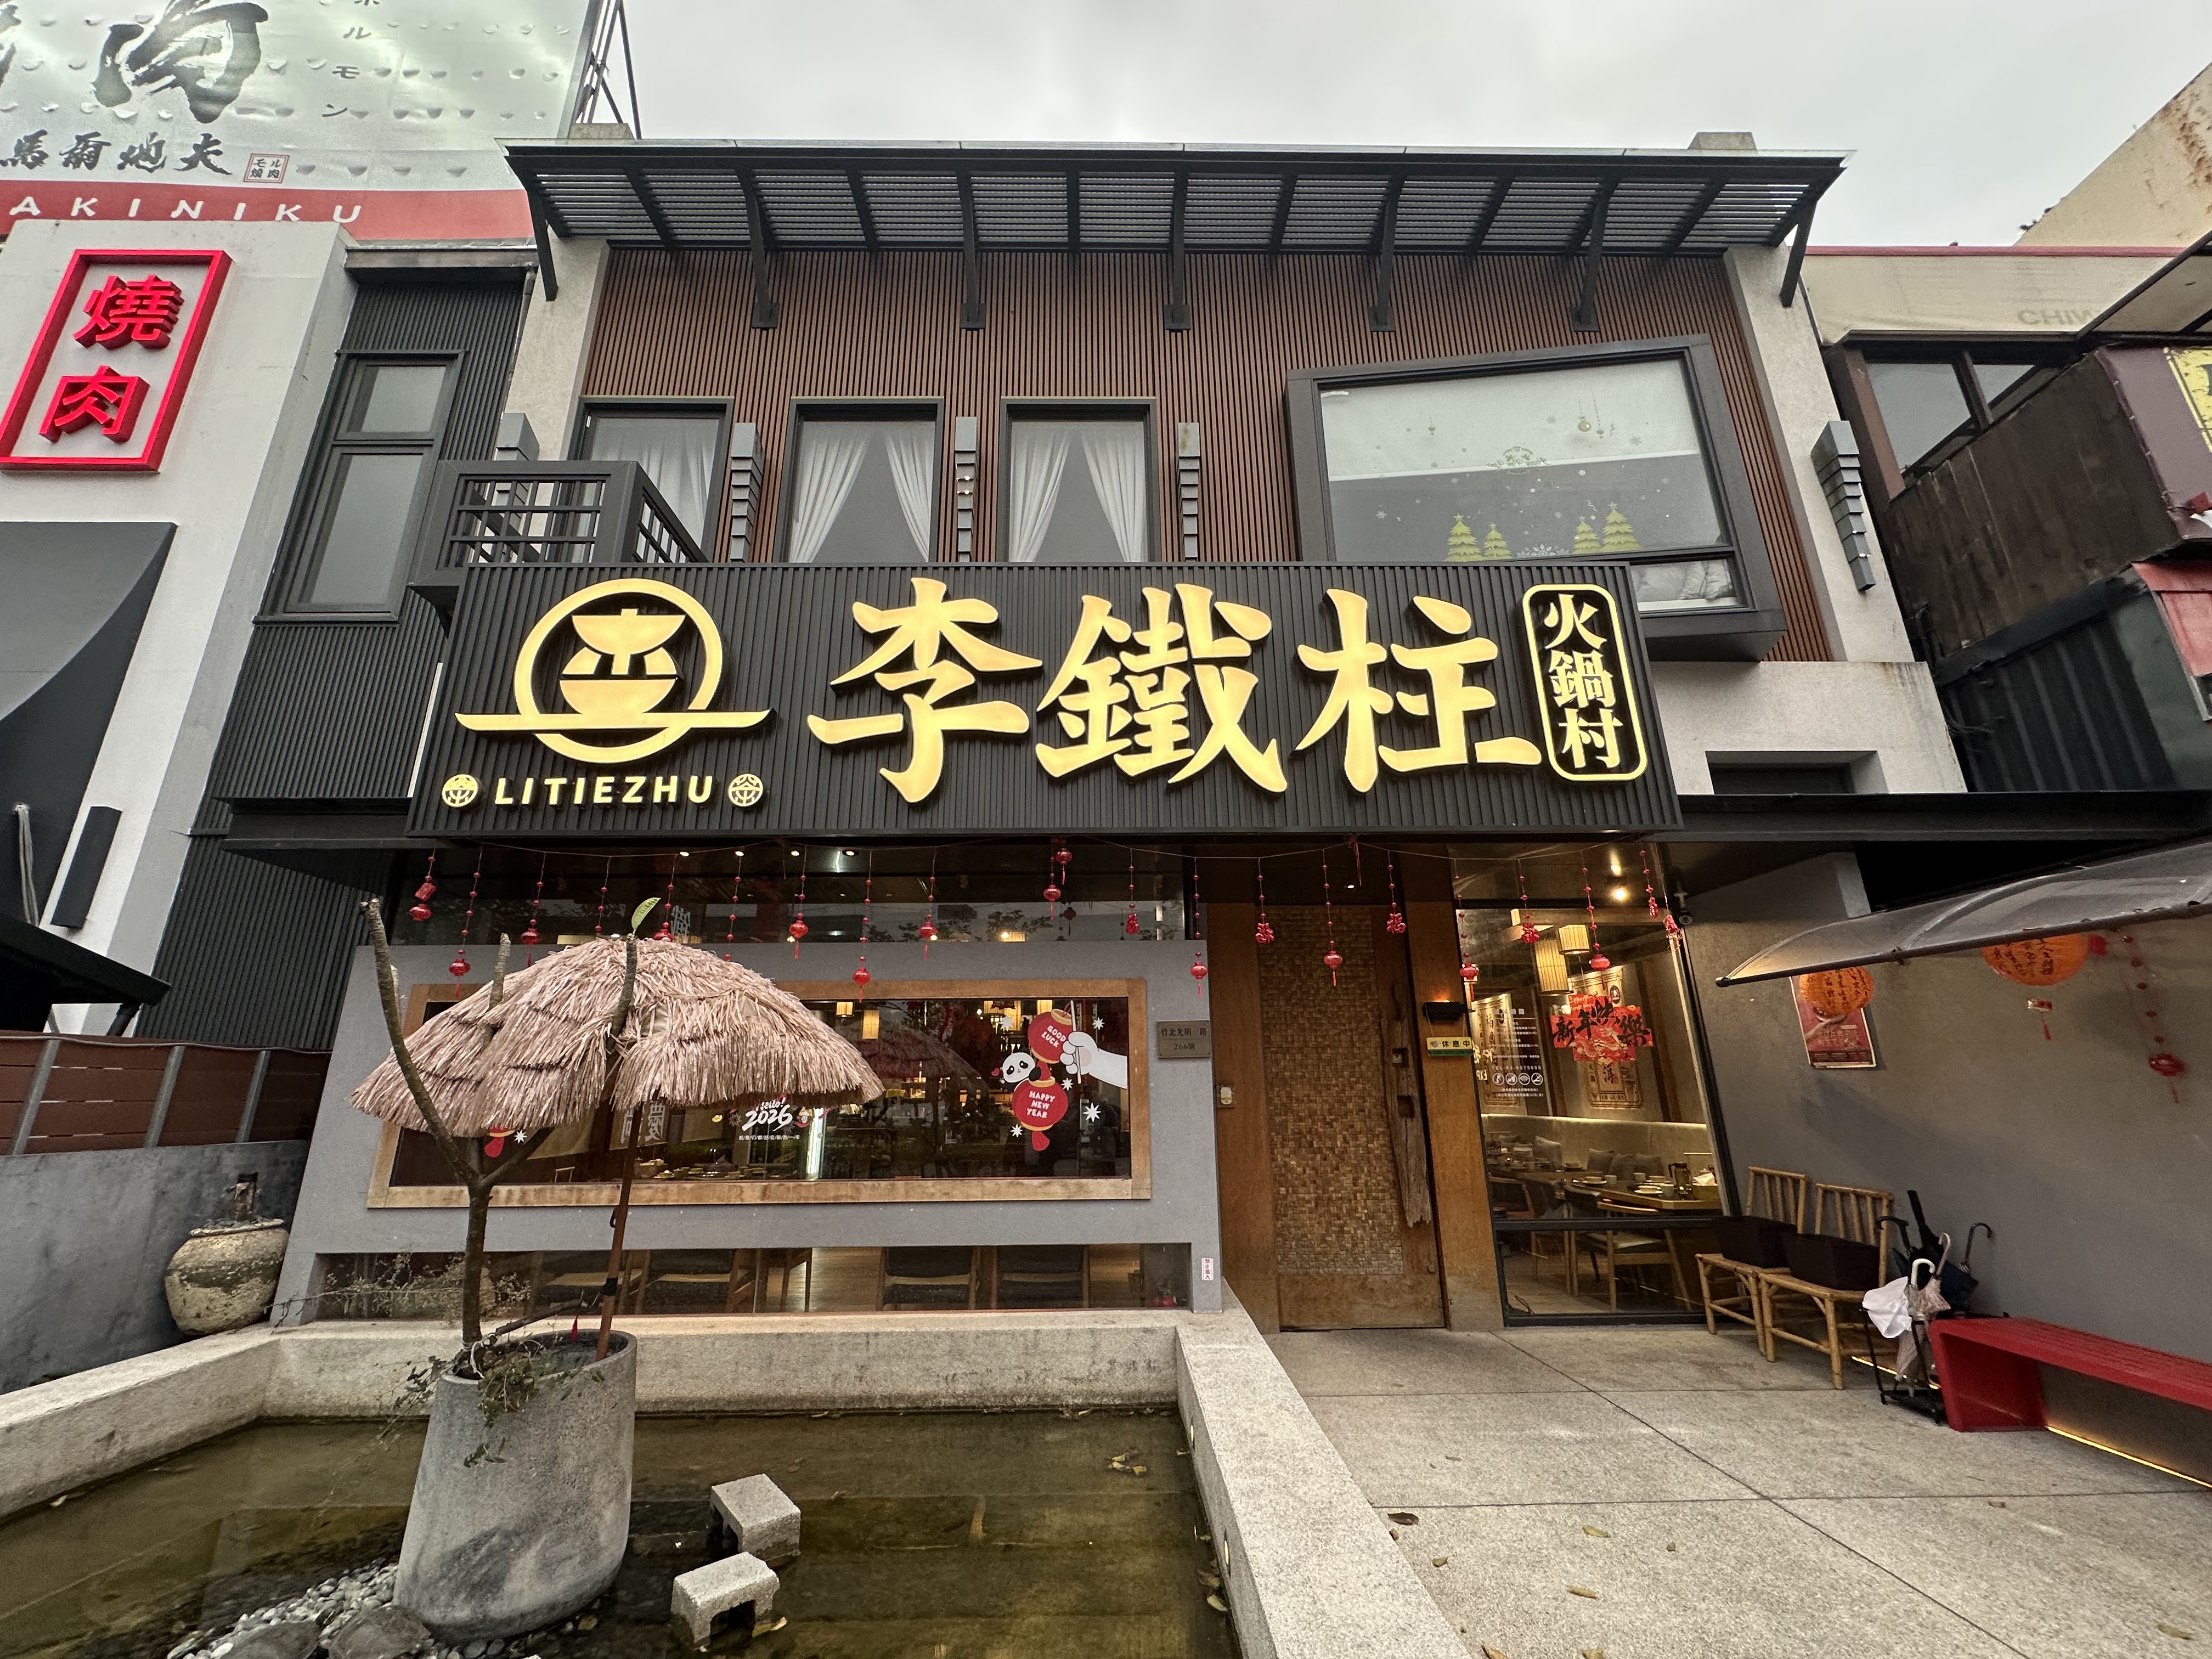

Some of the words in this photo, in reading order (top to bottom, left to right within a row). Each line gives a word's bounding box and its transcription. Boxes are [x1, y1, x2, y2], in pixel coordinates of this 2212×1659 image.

[39, 274, 184, 443] 燒肉
[807, 577, 1542, 804] 李鐵柱
[1544, 594, 1623, 770] 火鍋村
[494, 775, 713, 805] LITIEZHU
[1041, 1031, 1059, 1048] LUCK
[1047, 1025, 1066, 1042] GOOD
[1029, 1091, 1056, 1103] HAPPY
[1031, 1100, 1049, 1110] NEW
[742, 1104, 793, 1132] 2026
[1026, 1108, 1047, 1119] YEAR
